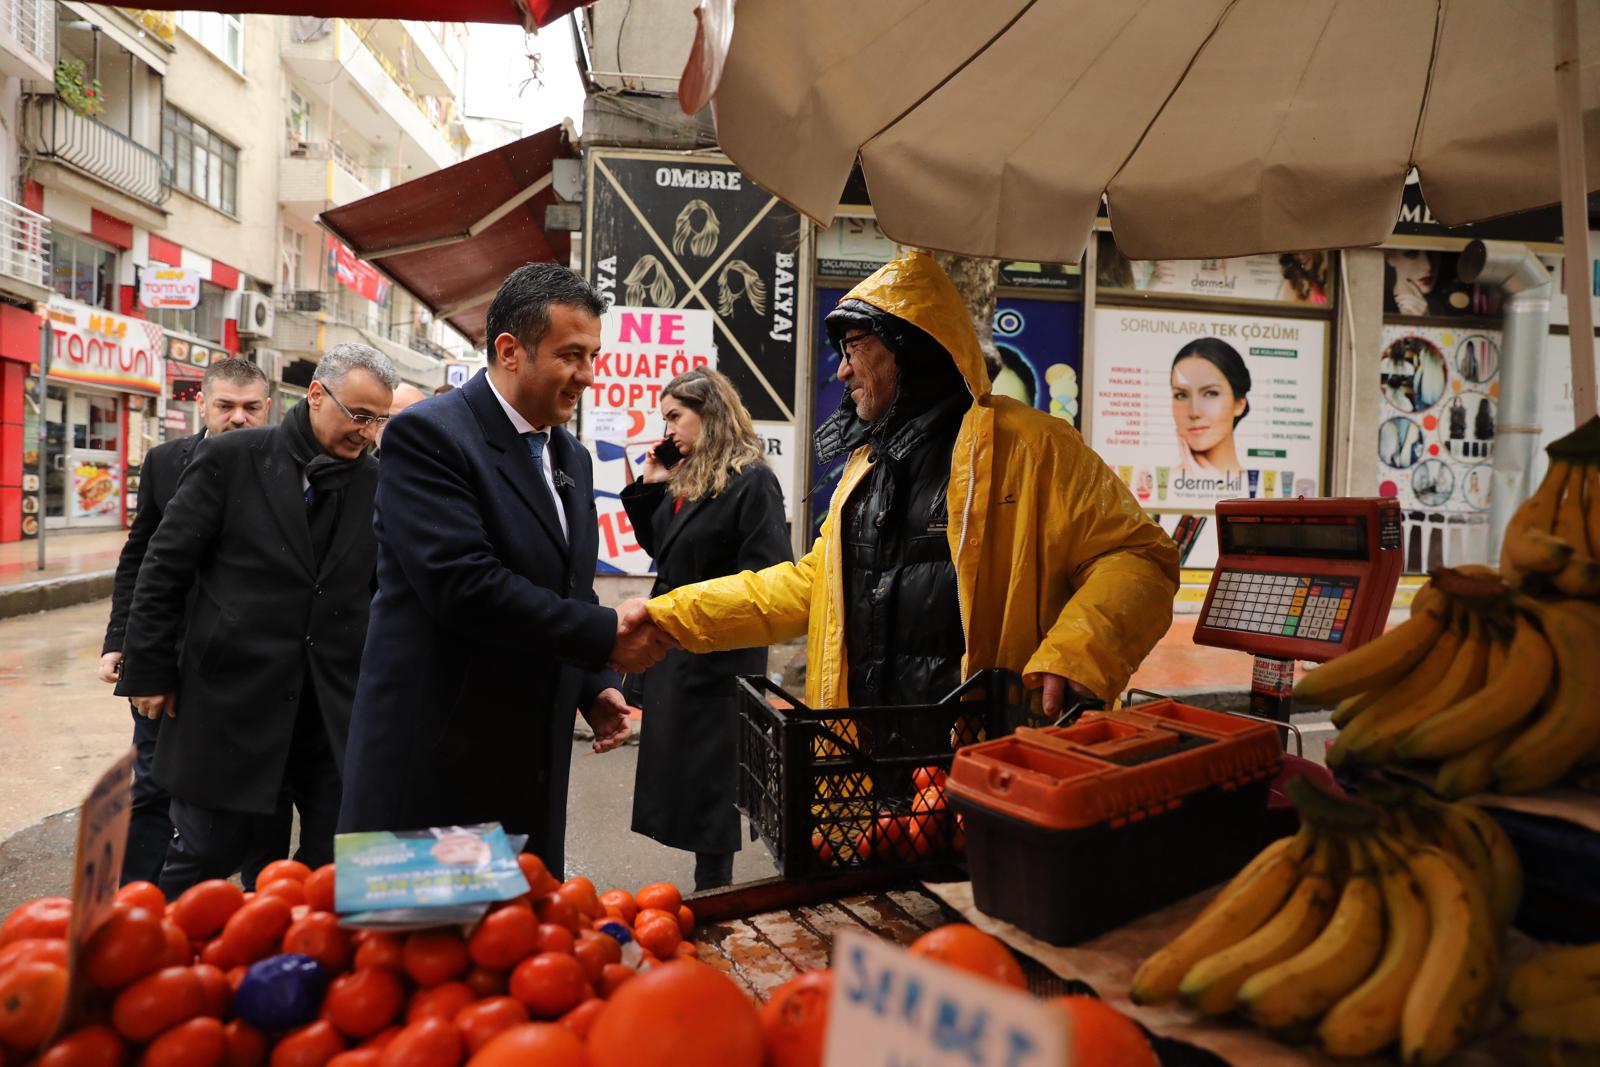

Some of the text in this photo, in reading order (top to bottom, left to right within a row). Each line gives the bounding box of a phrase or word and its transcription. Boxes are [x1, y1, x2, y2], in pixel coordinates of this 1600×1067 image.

[655, 168, 742, 191] OMBRE
[773, 252, 795, 342] BALYAJ
[617, 312, 686, 345] NE
[1120, 318, 1300, 342] SORUNLARA TEK ÇÖZÜM!
